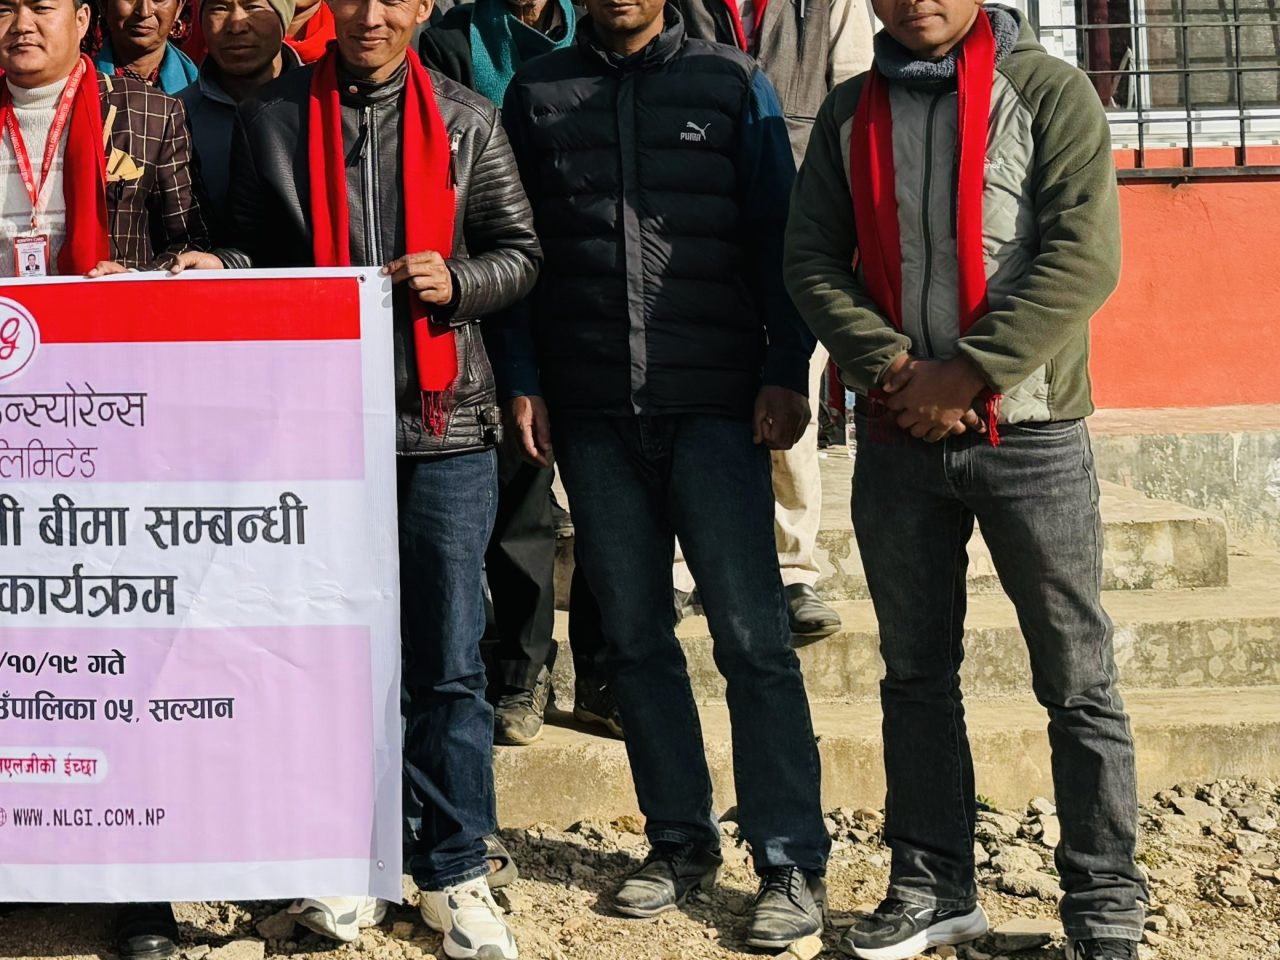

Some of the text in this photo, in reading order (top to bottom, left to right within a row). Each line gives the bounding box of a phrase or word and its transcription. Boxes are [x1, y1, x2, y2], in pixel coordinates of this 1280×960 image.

[680, 132, 702, 142] PUMA
[39, 493, 129, 547] बीमा
[144, 491, 308, 546] सम्बन्धी
[87, 648, 126, 675] गते
[148, 697, 236, 721] सल्यान
[12, 807, 166, 828] WWW.NLGI.COM.NP
